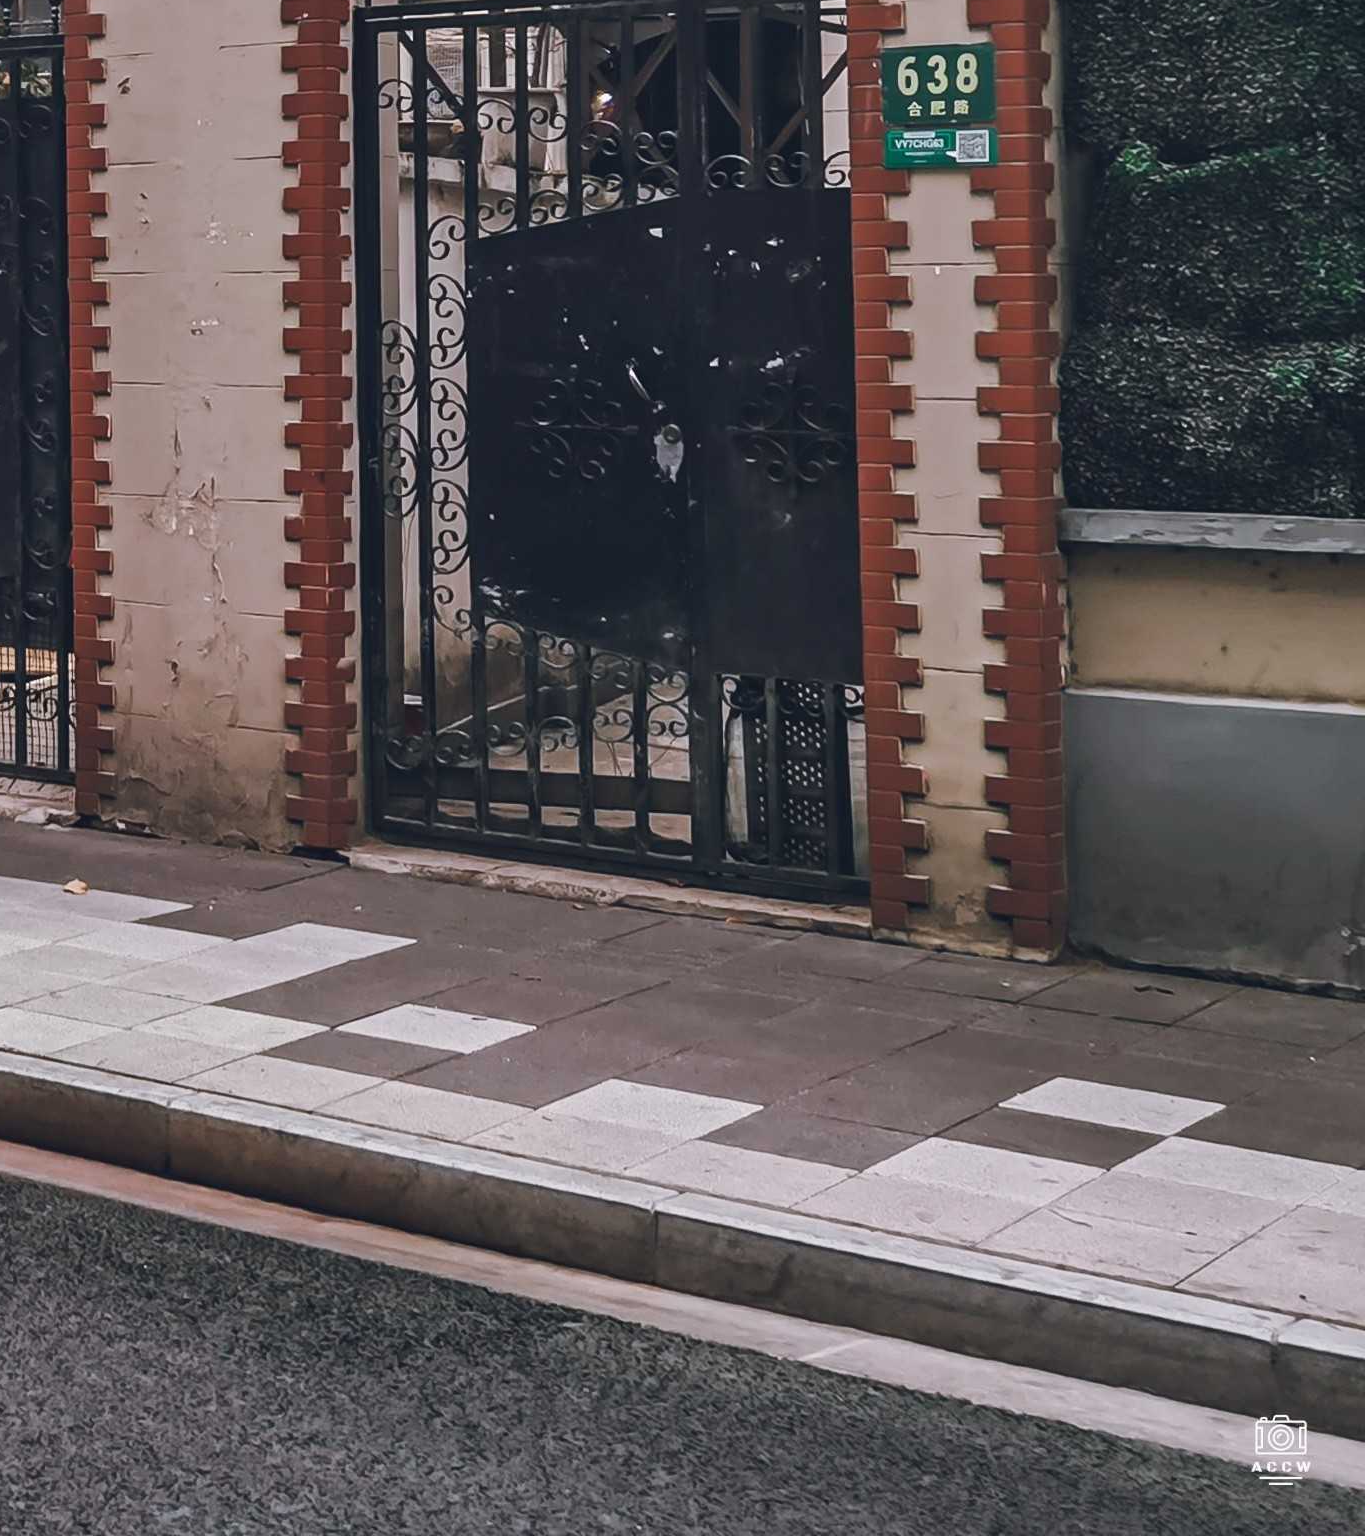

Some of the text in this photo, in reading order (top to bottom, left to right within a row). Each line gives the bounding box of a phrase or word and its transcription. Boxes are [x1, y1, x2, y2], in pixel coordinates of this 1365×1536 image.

[897, 52, 979, 97] 638
[906, 99, 970, 117] 合肥路
